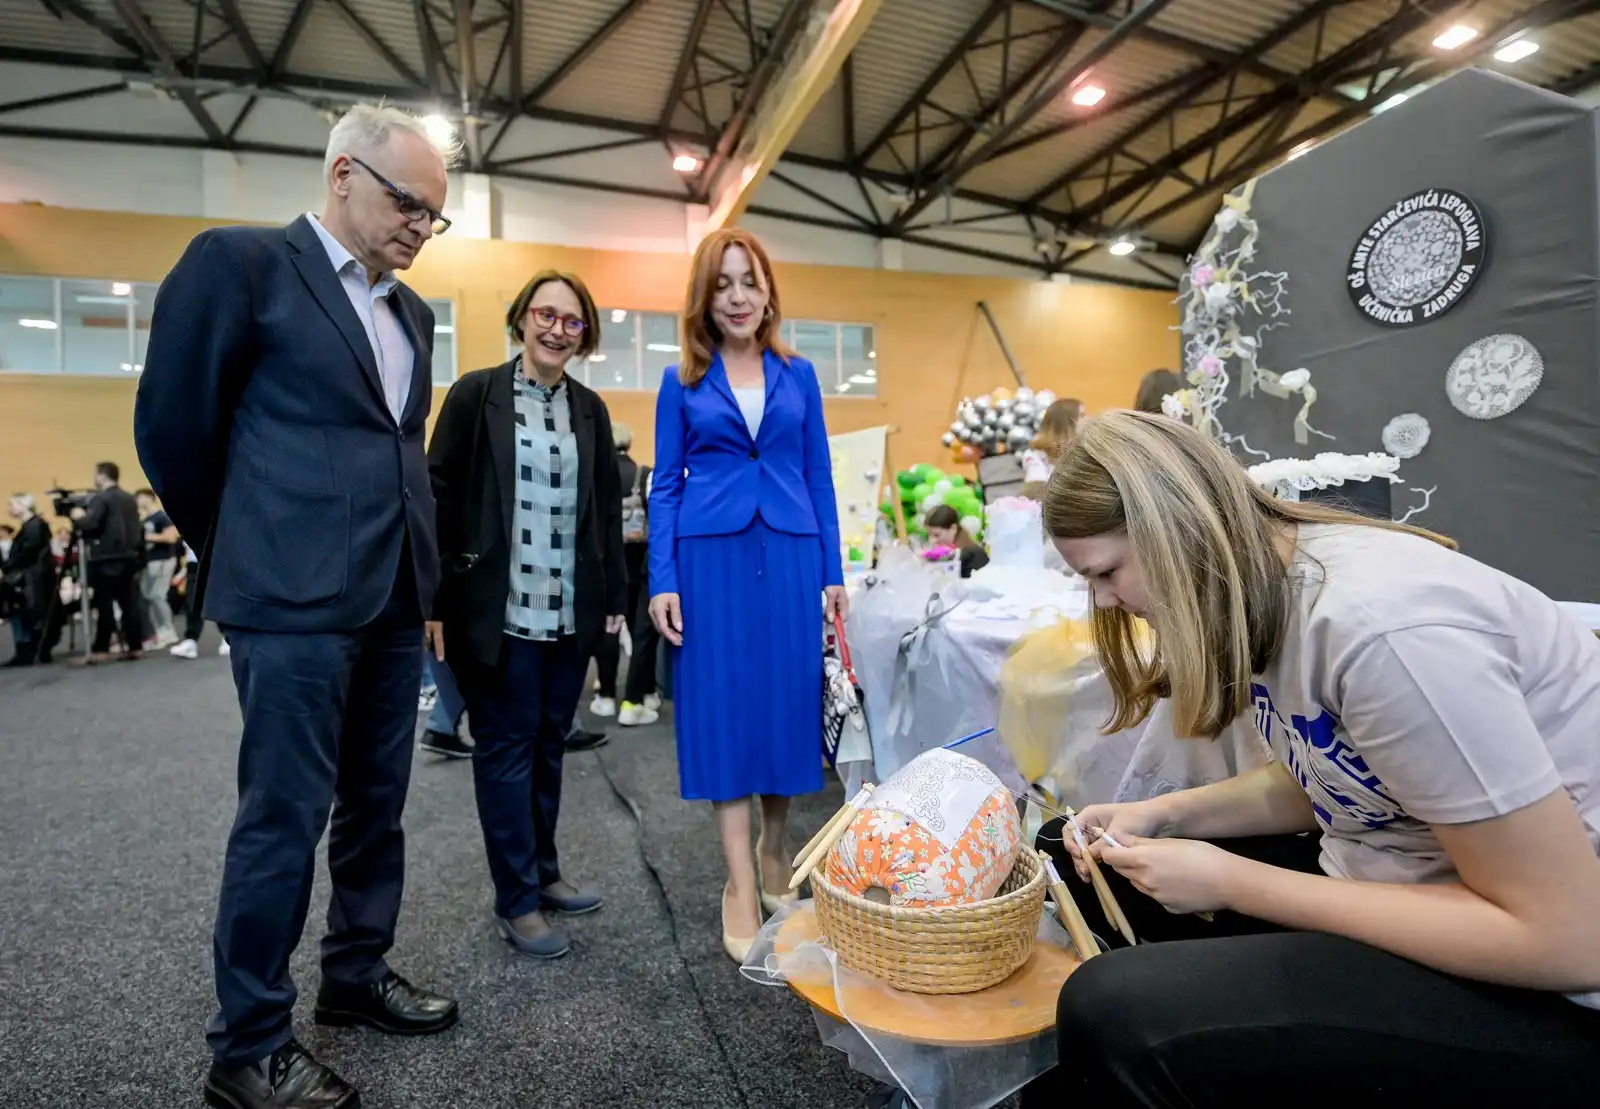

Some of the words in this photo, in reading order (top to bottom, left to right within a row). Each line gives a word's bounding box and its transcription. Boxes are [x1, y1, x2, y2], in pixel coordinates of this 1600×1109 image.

[1368, 188, 1439, 239] STARČEVIĆA
[1439, 193, 1480, 251] LEPOGLAVA
[1352, 238, 1375, 269] ANTE
[1347, 271, 1365, 288] OŠ
[1358, 293, 1414, 323] UČENIČKA
[1422, 264, 1476, 318] ZADRUGA
